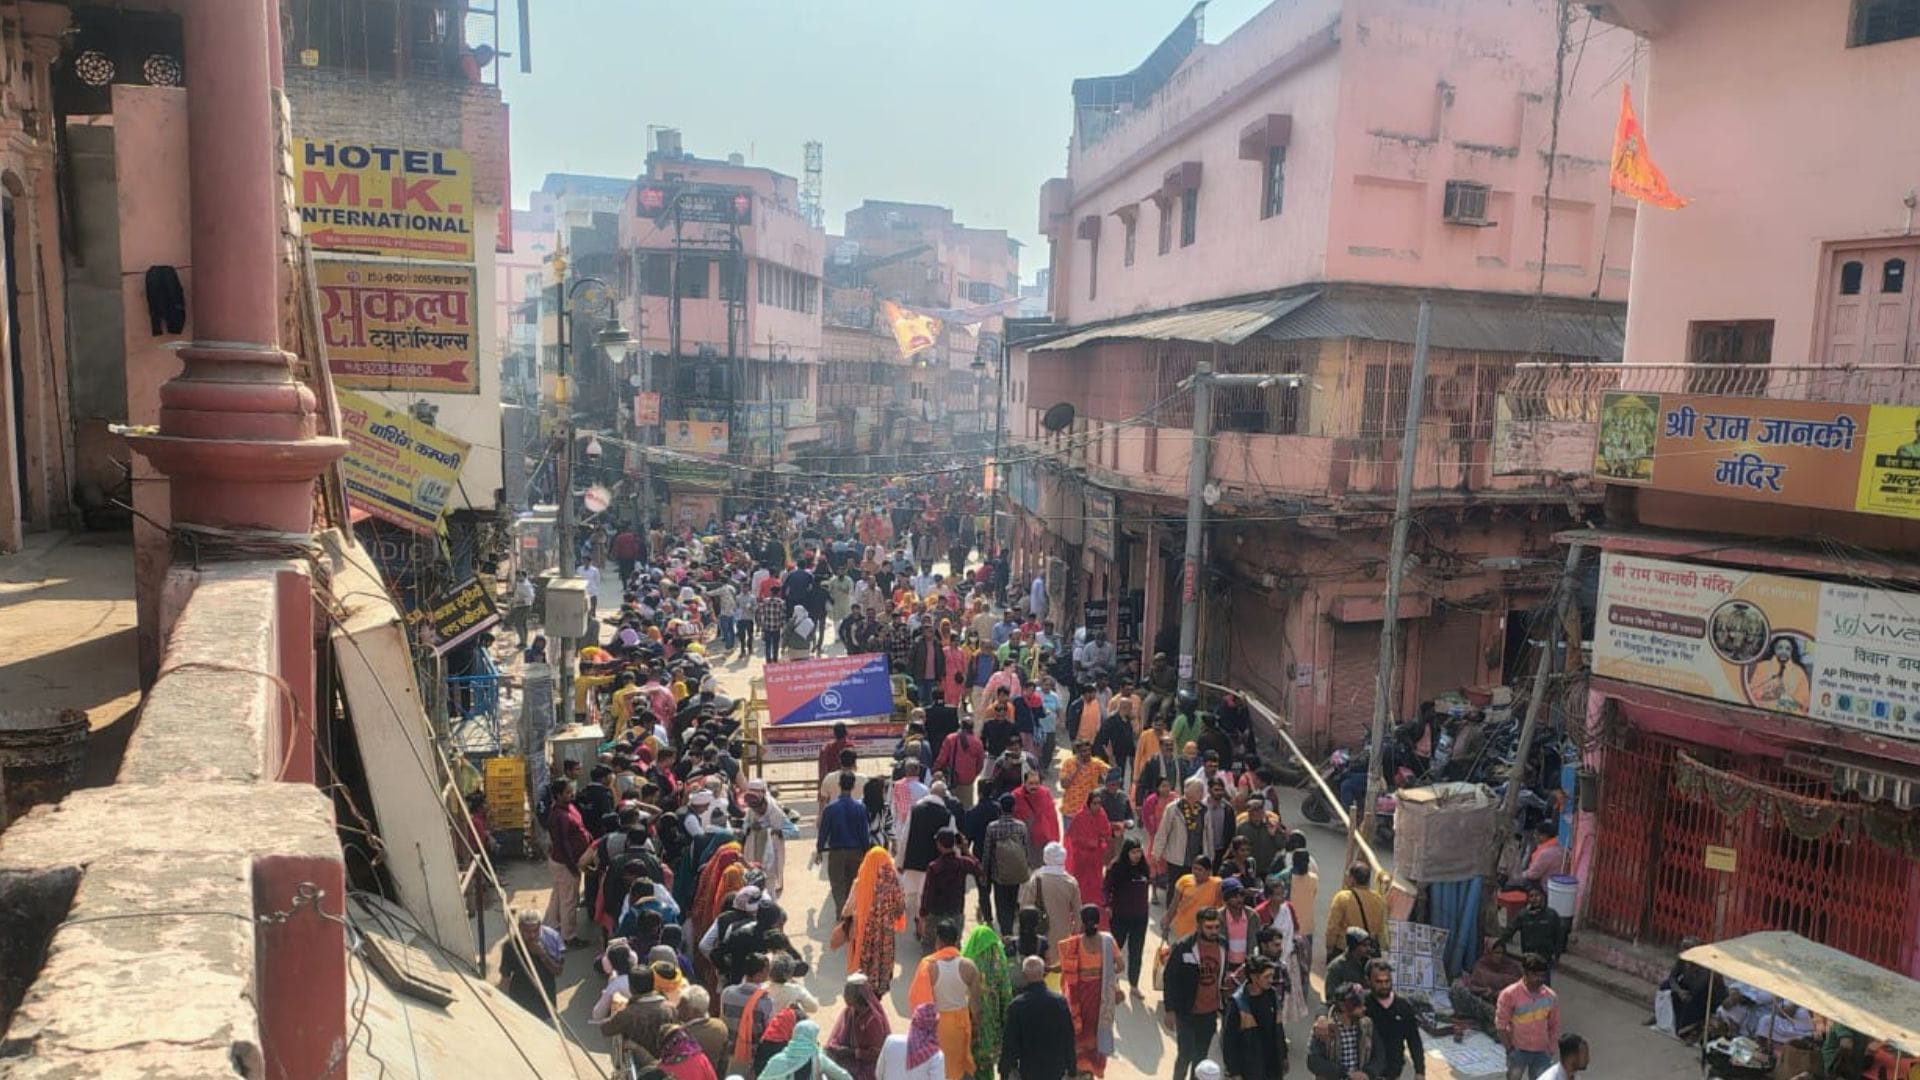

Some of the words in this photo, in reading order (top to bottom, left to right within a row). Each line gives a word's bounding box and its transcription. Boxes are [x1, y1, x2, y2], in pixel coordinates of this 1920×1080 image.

[305, 143, 457, 176] HOTEL
[302, 170, 463, 214] M.K.
[1666, 406, 1697, 437] श्री
[1703, 414, 1751, 442] राम
[1757, 415, 1856, 450] जानकी
[1716, 453, 1786, 491] मंदिर
[1611, 561, 1624, 578] श्री
[1629, 567, 1651, 582] राम
[1653, 569, 1697, 589] जानकी
[1701, 572, 1735, 595] मंदिर
